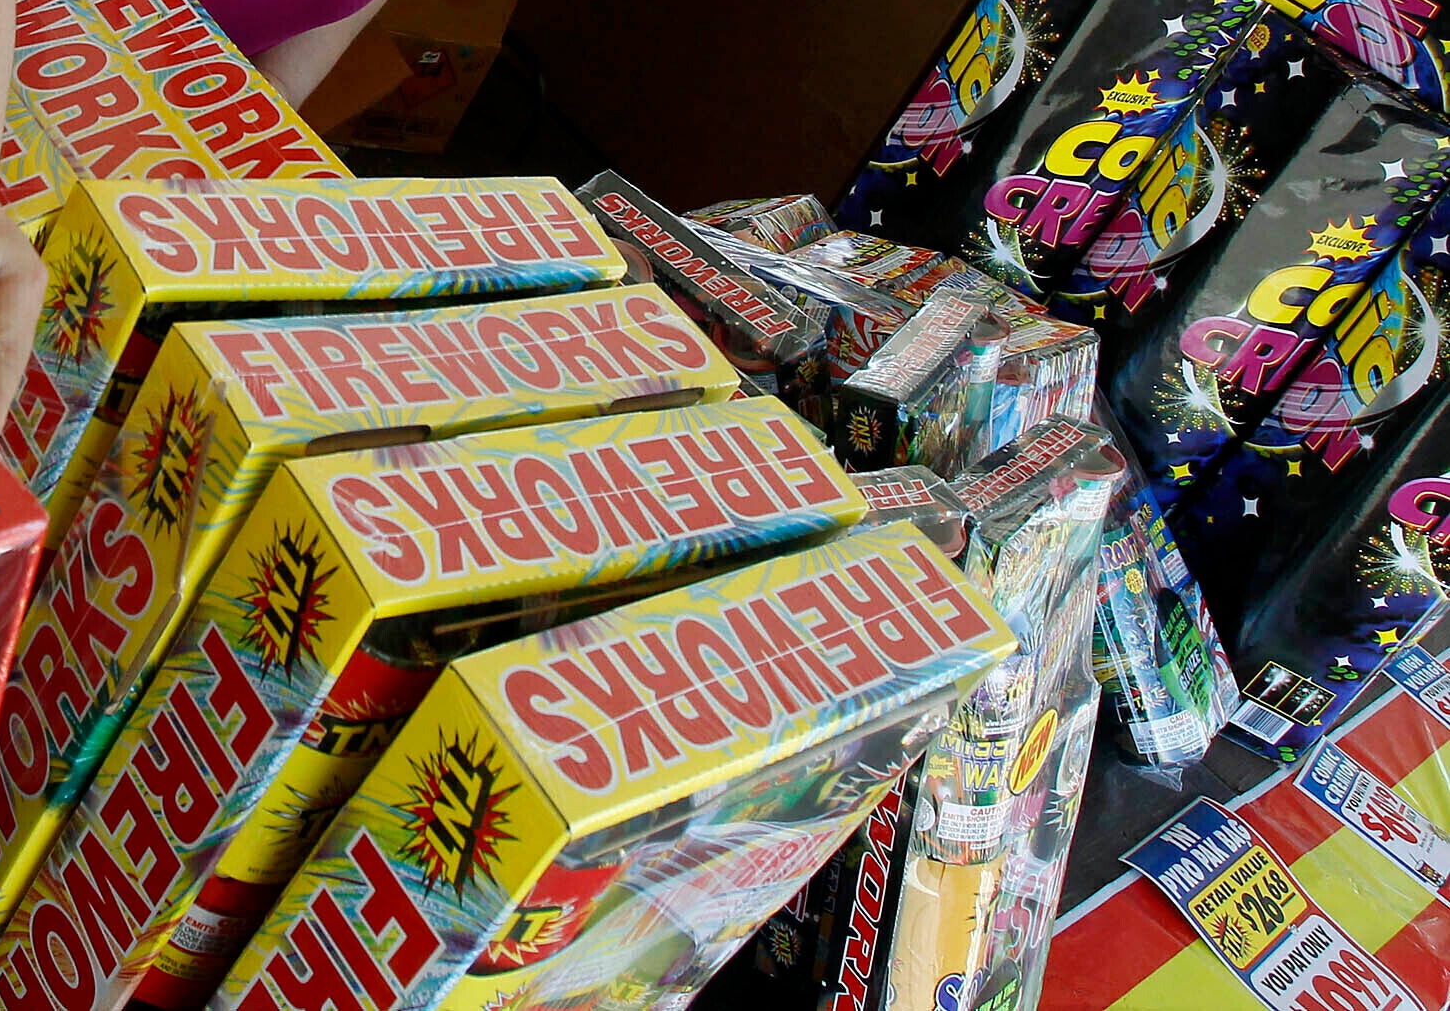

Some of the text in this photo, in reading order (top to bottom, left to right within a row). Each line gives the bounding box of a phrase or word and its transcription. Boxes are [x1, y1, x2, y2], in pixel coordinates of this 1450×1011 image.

[1106, 90, 1151, 106] EXCLUSIVE
[115, 189, 611, 276] FIREWORKS
[593, 192, 798, 339] FIREWORKS
[1316, 234, 1367, 253] EXCLUSIVE
[207, 293, 711, 421] FIREWORKS
[851, 414, 873, 453] TNT
[330, 413, 843, 587] FIREWORKS
[503, 543, 997, 794] FIREWORKS
[1396, 652, 1424, 677] HIGH
[1403, 660, 1445, 693] VOLTAGE
[1018, 712, 1056, 782] NEW
[423, 747, 489, 888] TNT
[1159, 822, 1202, 852] TNT
[1158, 818, 1253, 901] PYRO PAK BAG
[1194, 852, 1270, 921] RETAIL VALUE
[1261, 925, 1335, 996] YOU PAY ONLY
